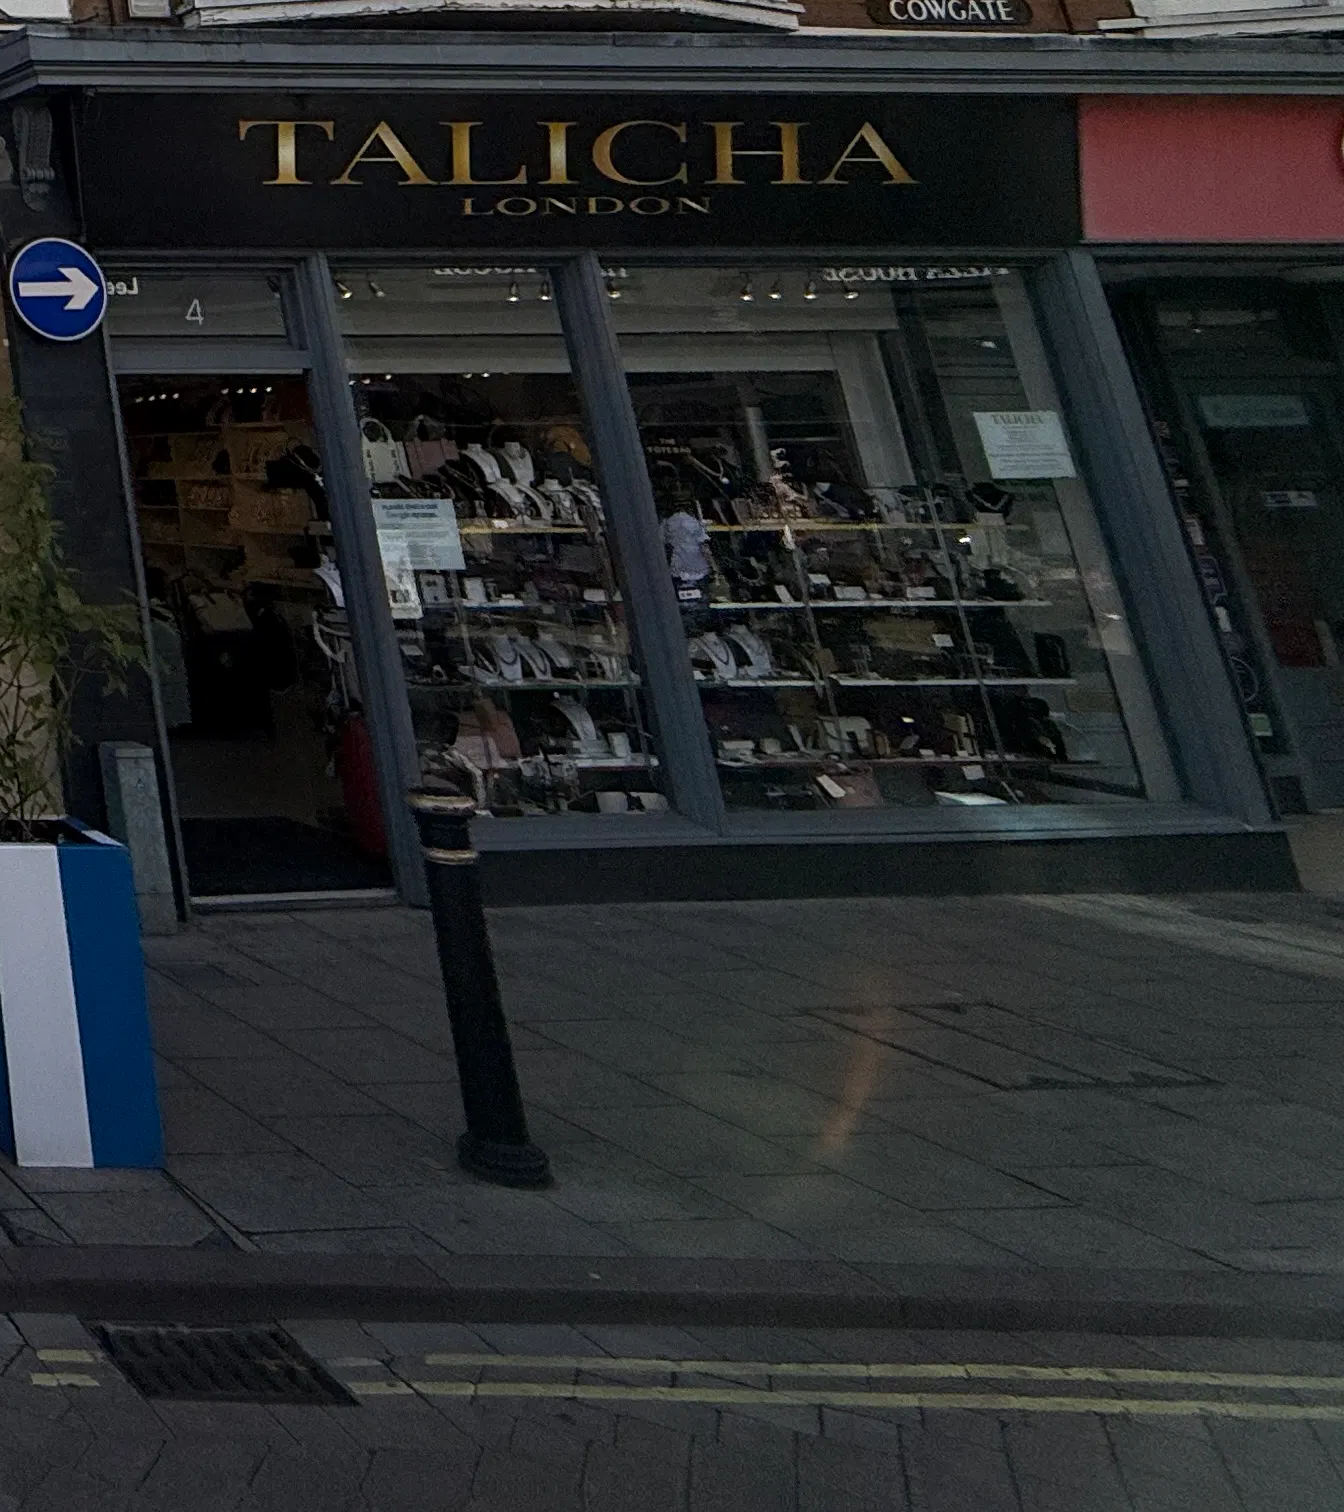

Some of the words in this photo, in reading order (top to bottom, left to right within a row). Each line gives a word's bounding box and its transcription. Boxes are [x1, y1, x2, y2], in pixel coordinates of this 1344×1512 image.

[238, 120, 920, 186] TALICHA
[461, 196, 711, 216] LONDON
[185, 298, 204, 325] 4
